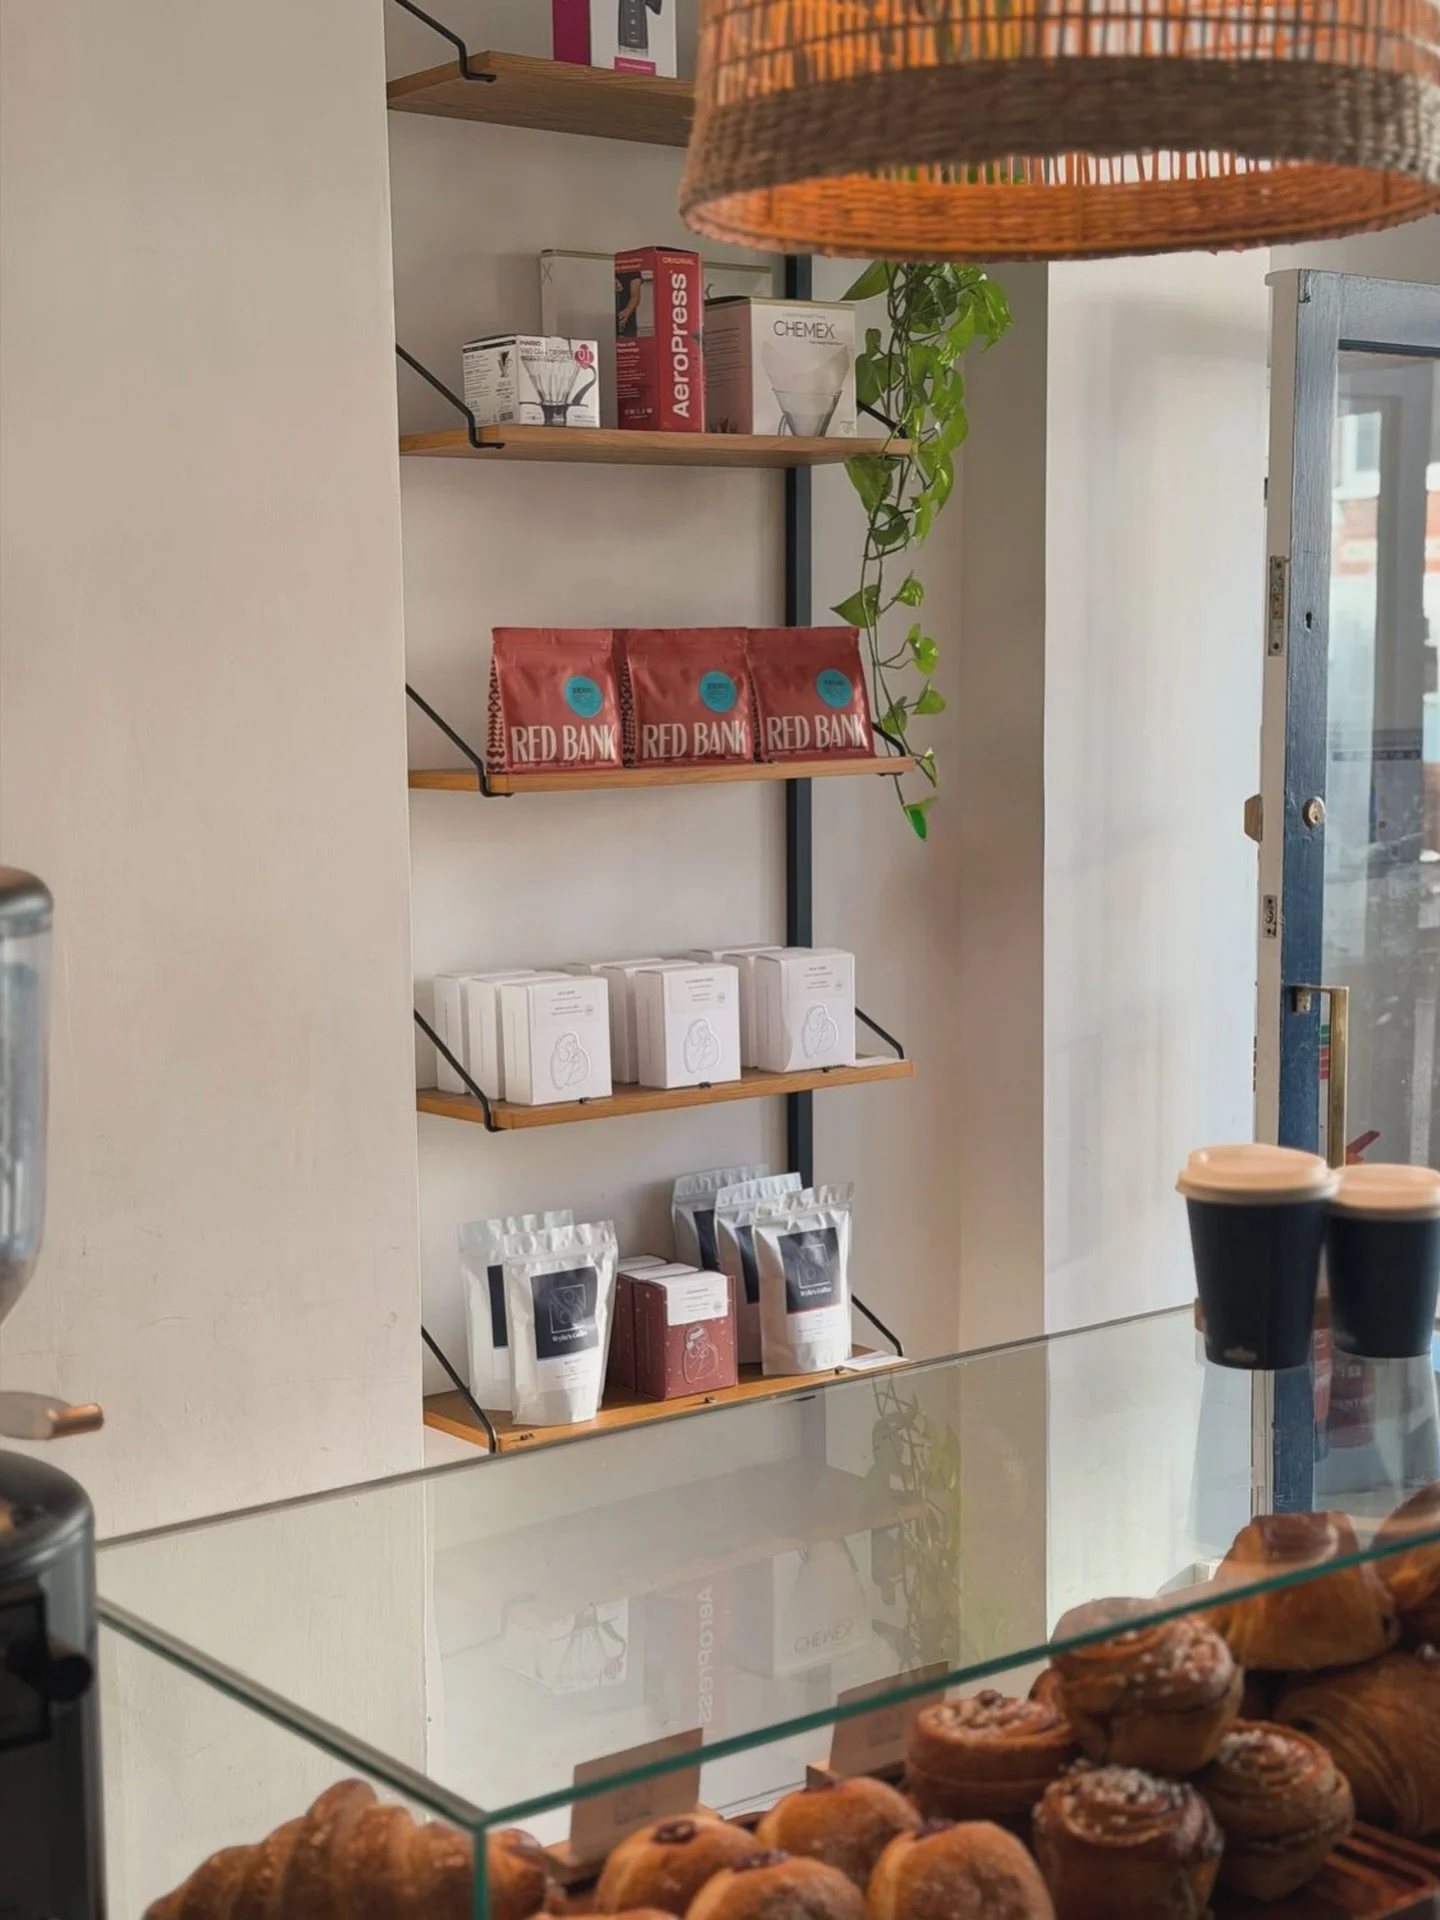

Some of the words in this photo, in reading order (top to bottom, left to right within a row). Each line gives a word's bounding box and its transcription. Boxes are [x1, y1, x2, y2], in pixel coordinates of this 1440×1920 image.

[671, 272, 690, 419] AeroPress
[773, 320, 837, 340] CHEMEX
[511, 725, 557, 762] RED
[562, 723, 618, 761] BANK
[642, 723, 688, 759] RED
[693, 719, 747, 756] BANK
[766, 715, 810, 750] RED
[814, 713, 869, 751] BANK
